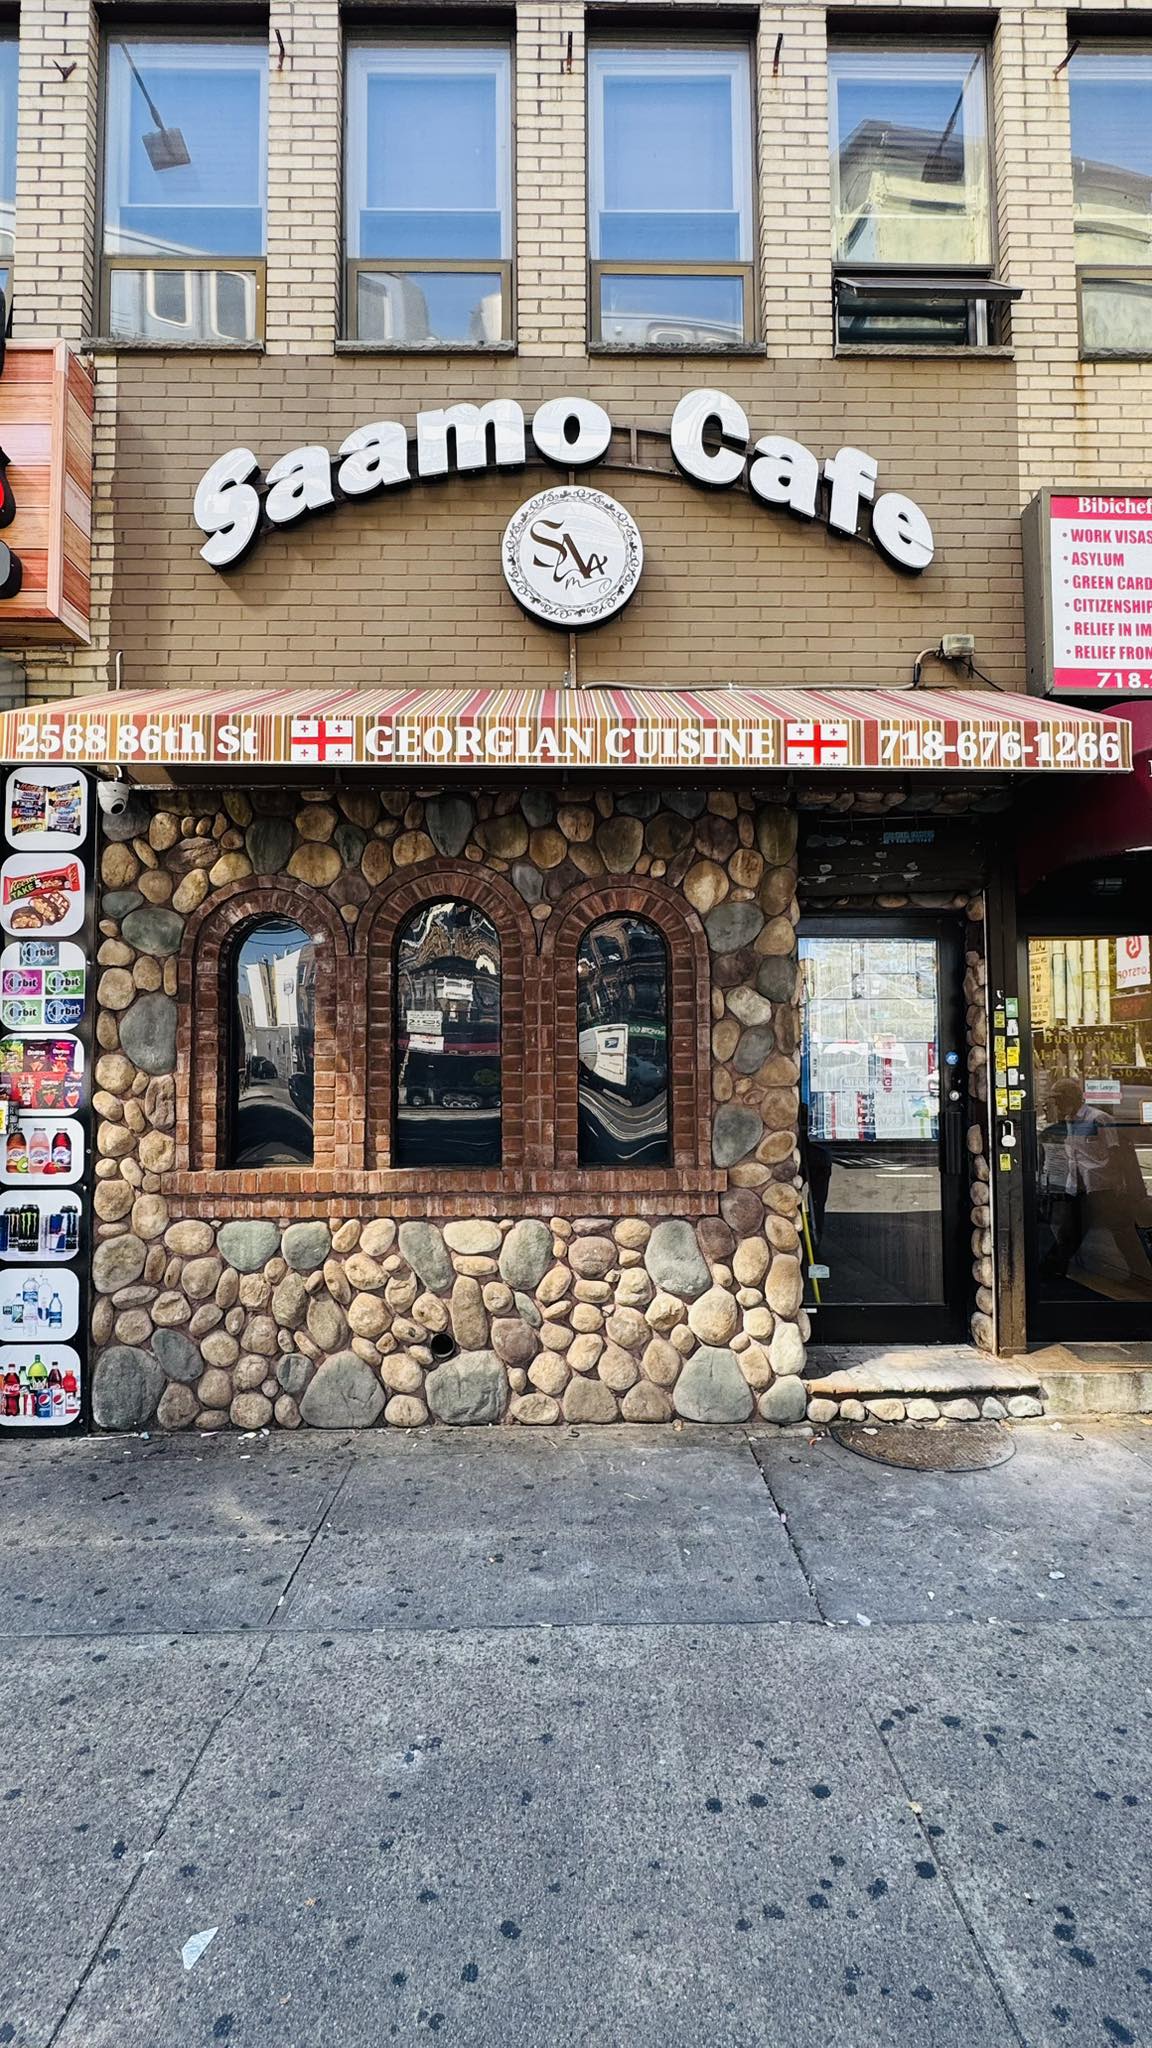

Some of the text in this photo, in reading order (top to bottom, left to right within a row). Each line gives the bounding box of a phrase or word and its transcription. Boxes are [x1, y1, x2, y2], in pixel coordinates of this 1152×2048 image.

[194, 388, 936, 570] Saamo Cafe
[1070, 529, 1152, 545] WORK VISAS
[1071, 551, 1125, 567] ASYLUM
[1072, 575, 1152, 591] GREEN CARD
[1073, 598, 1152, 614] CITIZENSHIP
[1074, 621, 1115, 637] RELIEF
[1118, 623, 1132, 637] IN
[1074, 645, 1116, 660] RELIEF
[1096, 671, 1152, 689] 718.
[16, 722, 258, 756] 2568 86th St
[365, 726, 775, 760] GEORGIAN CUISINE
[880, 728, 1121, 763] 718-676-1266
[22, 943, 57, 961] Orbit
[5, 972, 38, 991] Orbit
[46, 972, 80, 991] Orbit
[4, 1002, 37, 1021] Orbit
[47, 1001, 81, 1020] Orbit
[1043, 1034, 1107, 1044] Business
